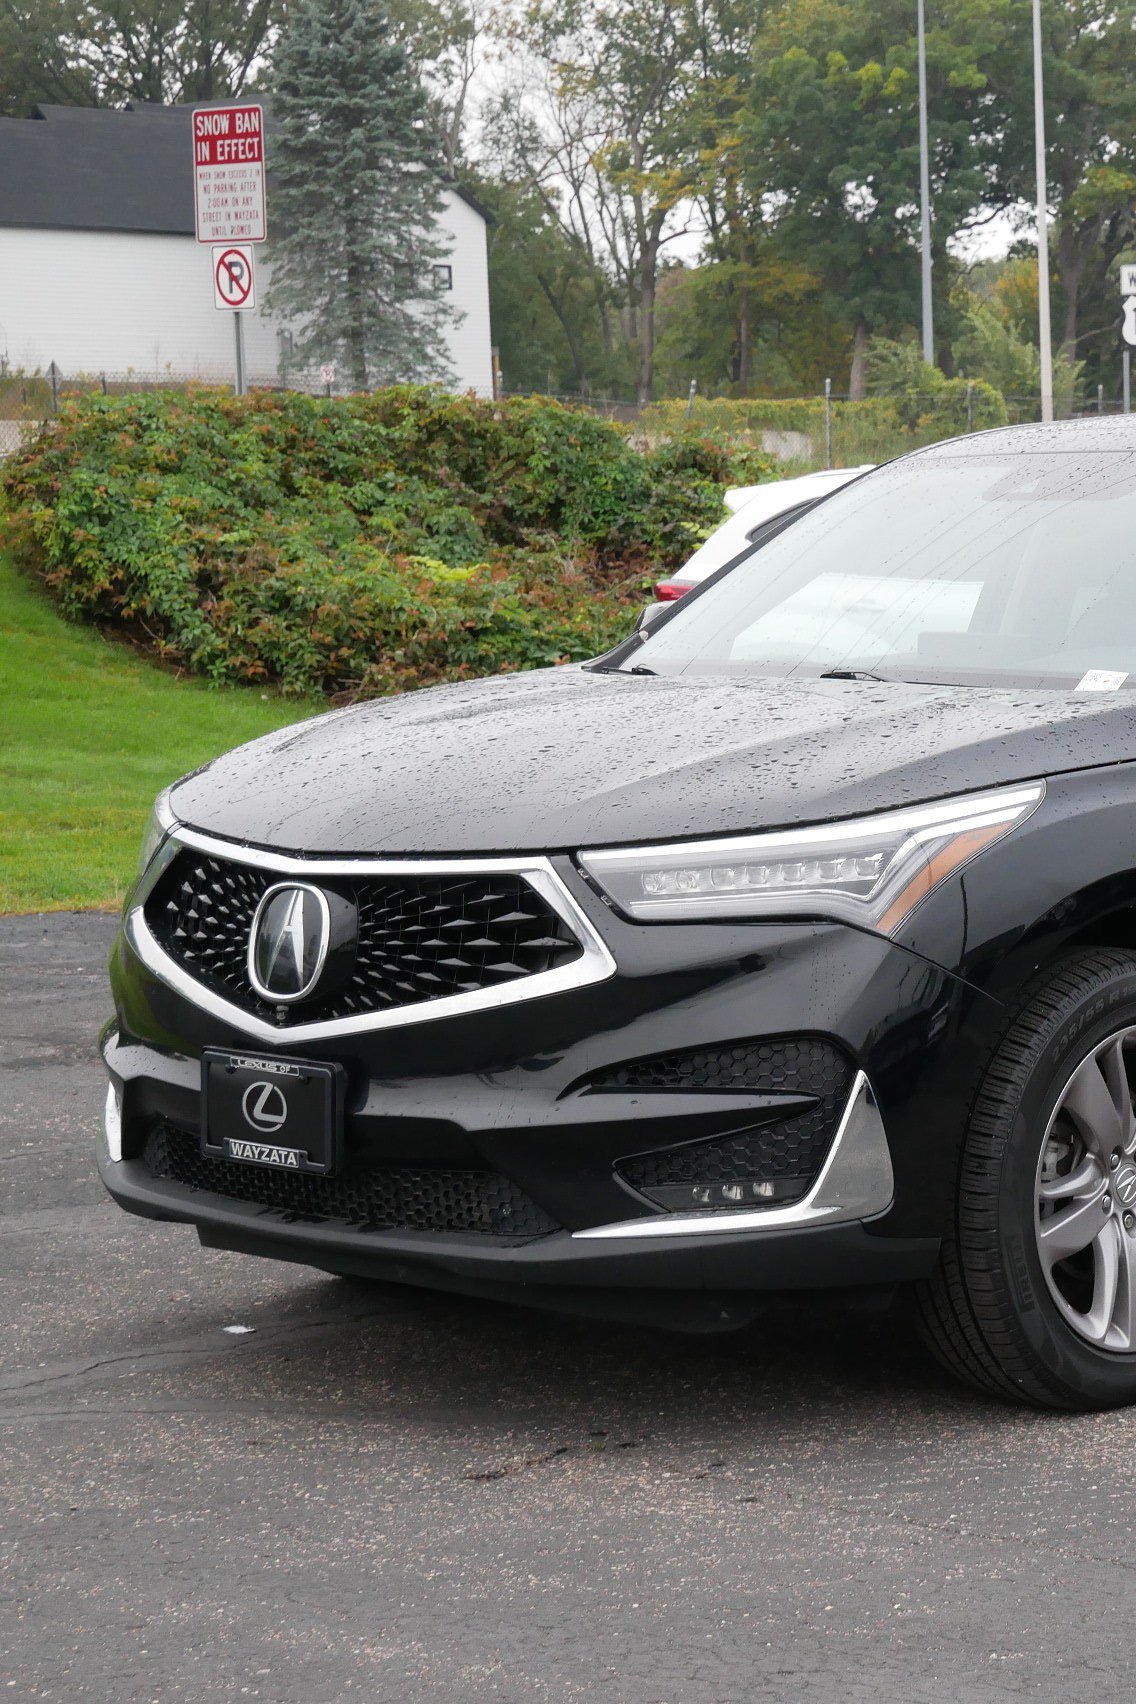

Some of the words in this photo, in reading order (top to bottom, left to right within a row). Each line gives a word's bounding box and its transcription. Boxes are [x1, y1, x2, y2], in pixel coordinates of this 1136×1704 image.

[196, 114, 230, 136] SNOW
[235, 111, 259, 134] BAN
[197, 141, 210, 162] IN
[216, 137, 259, 161] EFFECT
[203, 183, 211, 194] NO
[214, 182, 237, 194] PARKING
[240, 181, 256, 192] AFTER
[231, 197, 239, 207] ON
[242, 196, 253, 207] ANY
[202, 211, 222, 223] STREET
[225, 211, 231, 221] IN
[234, 209, 259, 221] WAYZATA
[211, 225, 227, 236] UNTIL
[237, 1058, 278, 1073] LEXUS
[280, 1064, 291, 1074] OF
[231, 1142, 298, 1166] WAYZATA
